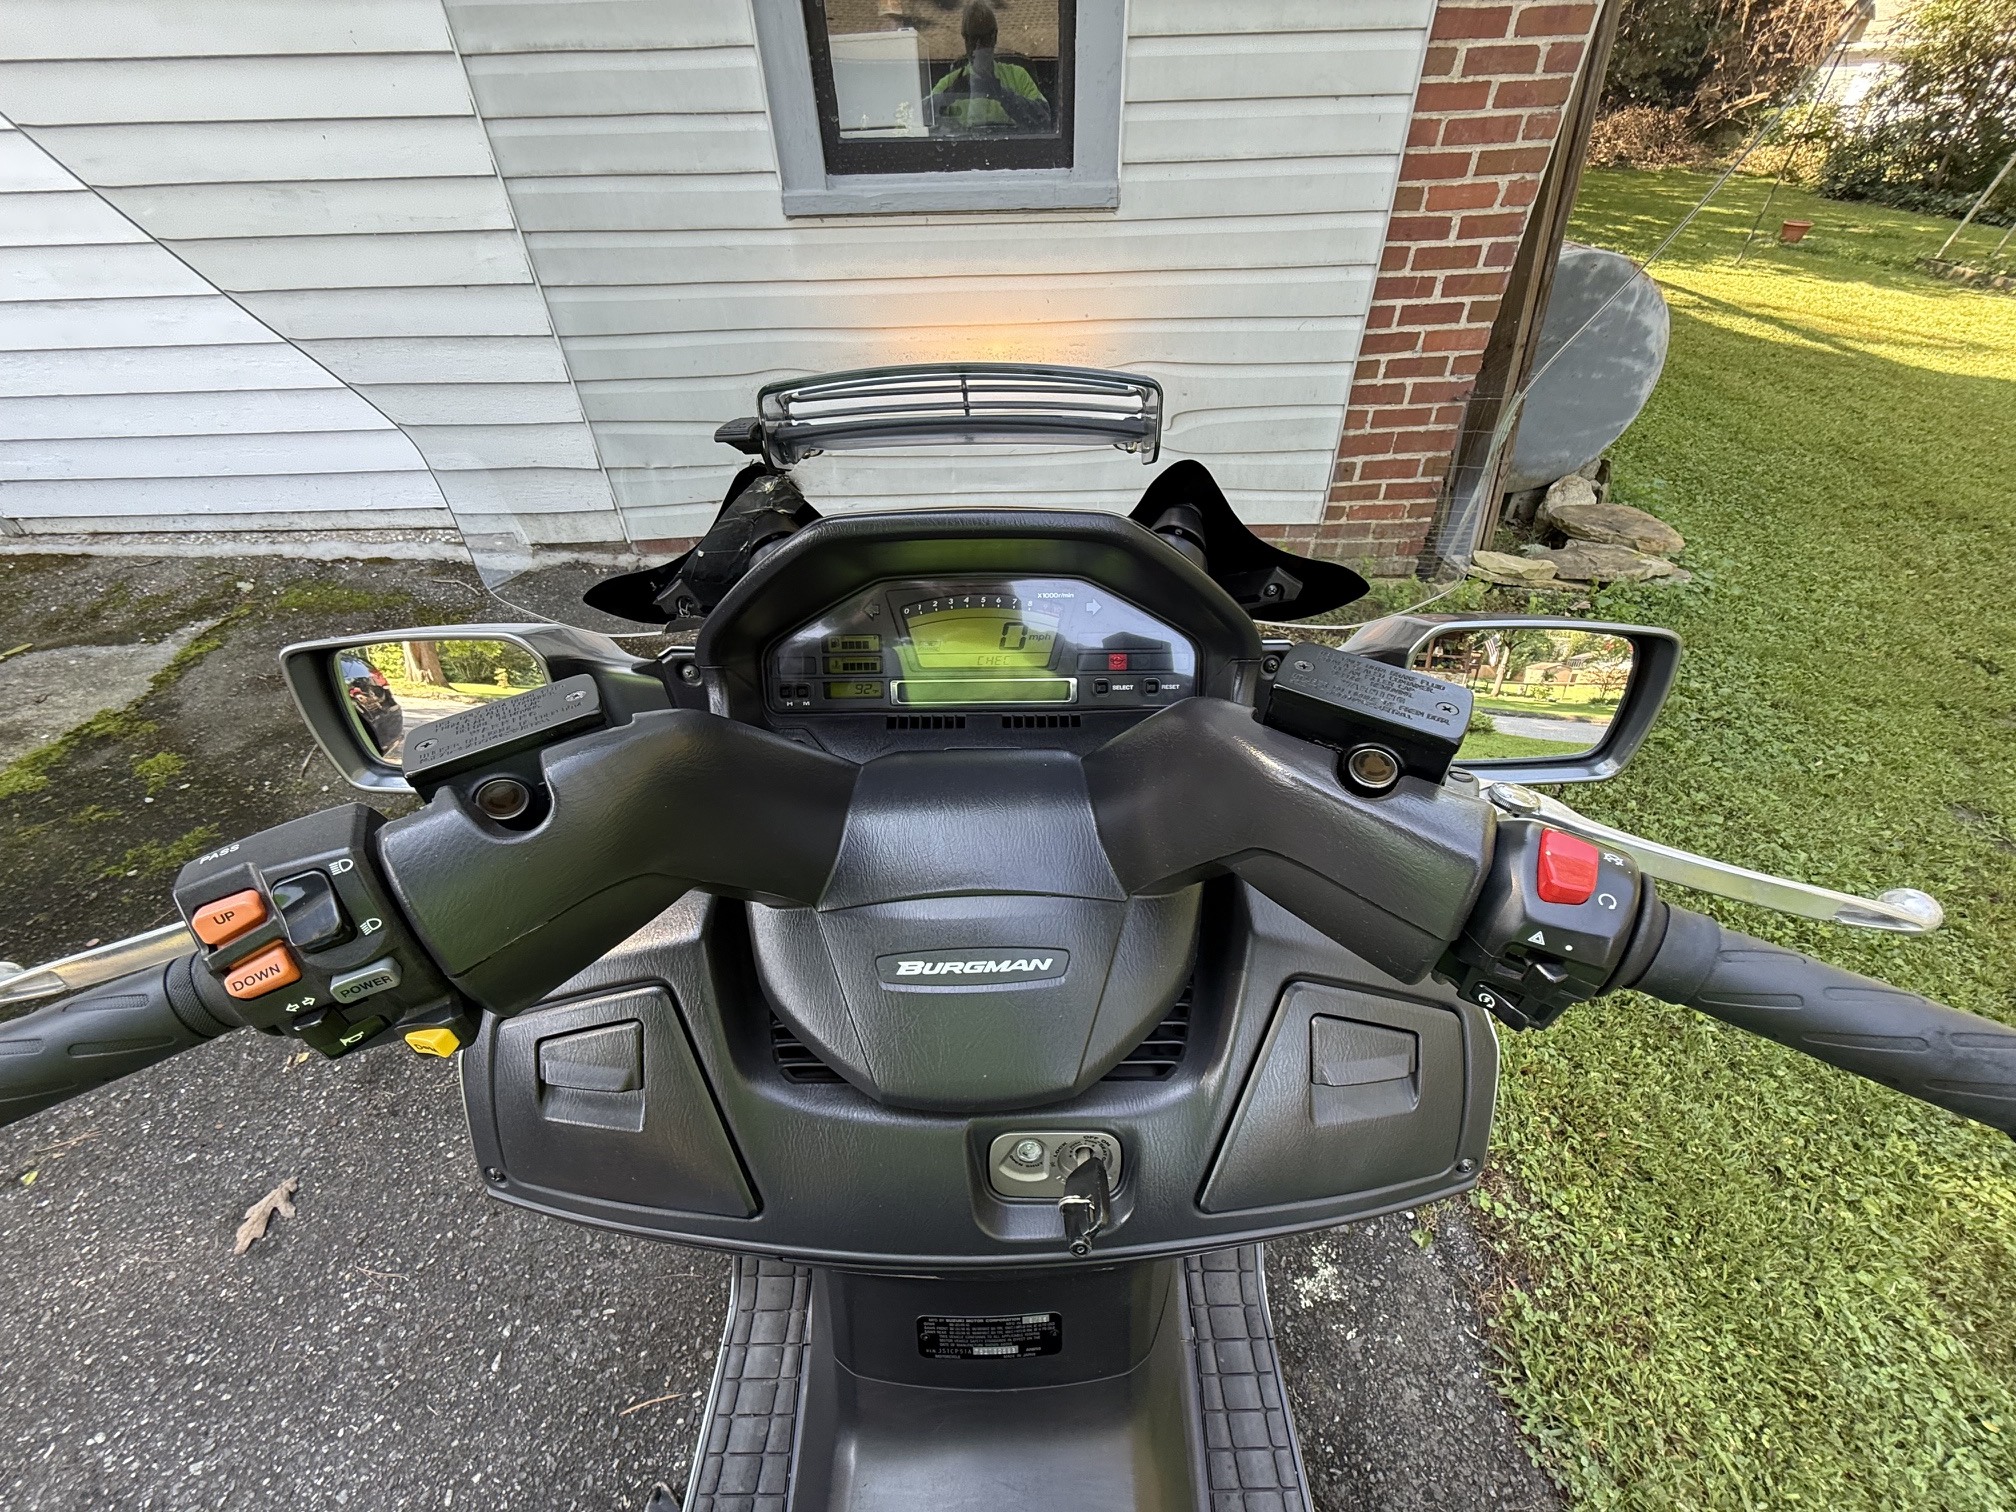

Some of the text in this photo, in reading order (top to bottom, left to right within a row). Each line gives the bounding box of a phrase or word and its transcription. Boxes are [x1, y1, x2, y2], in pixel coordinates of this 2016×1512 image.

[998, 621, 1051, 651] 0 mph
[199, 844, 240, 865] PASS
[212, 910, 235, 925] UP
[232, 963, 281, 992] DOWN
[896, 957, 1054, 976] BURGMAN
[340, 975, 393, 998] POWER
